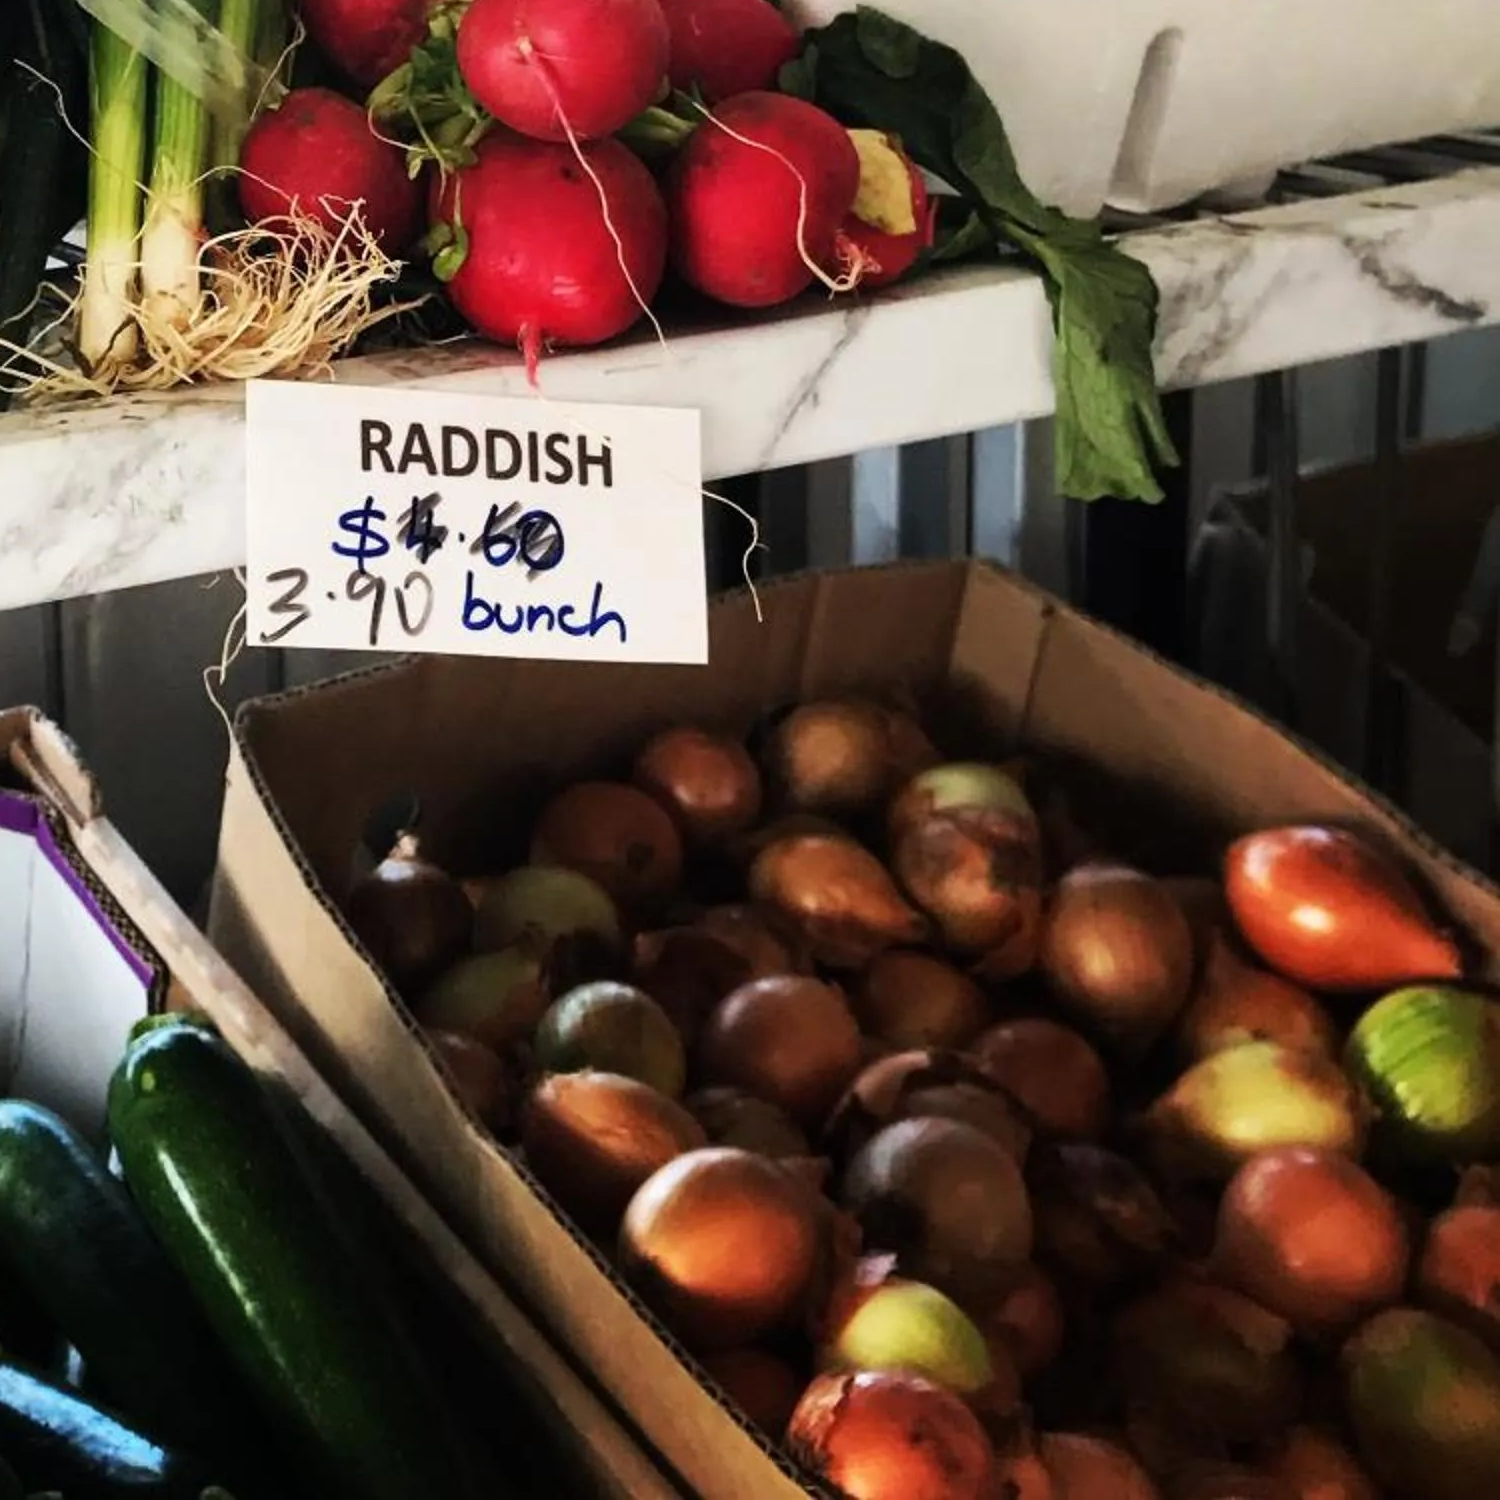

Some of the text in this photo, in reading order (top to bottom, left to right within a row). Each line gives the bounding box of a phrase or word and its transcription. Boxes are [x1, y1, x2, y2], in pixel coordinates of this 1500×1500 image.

[359, 418, 614, 488] RADDISH
[260, 566, 627, 645] 3.90 bunch
